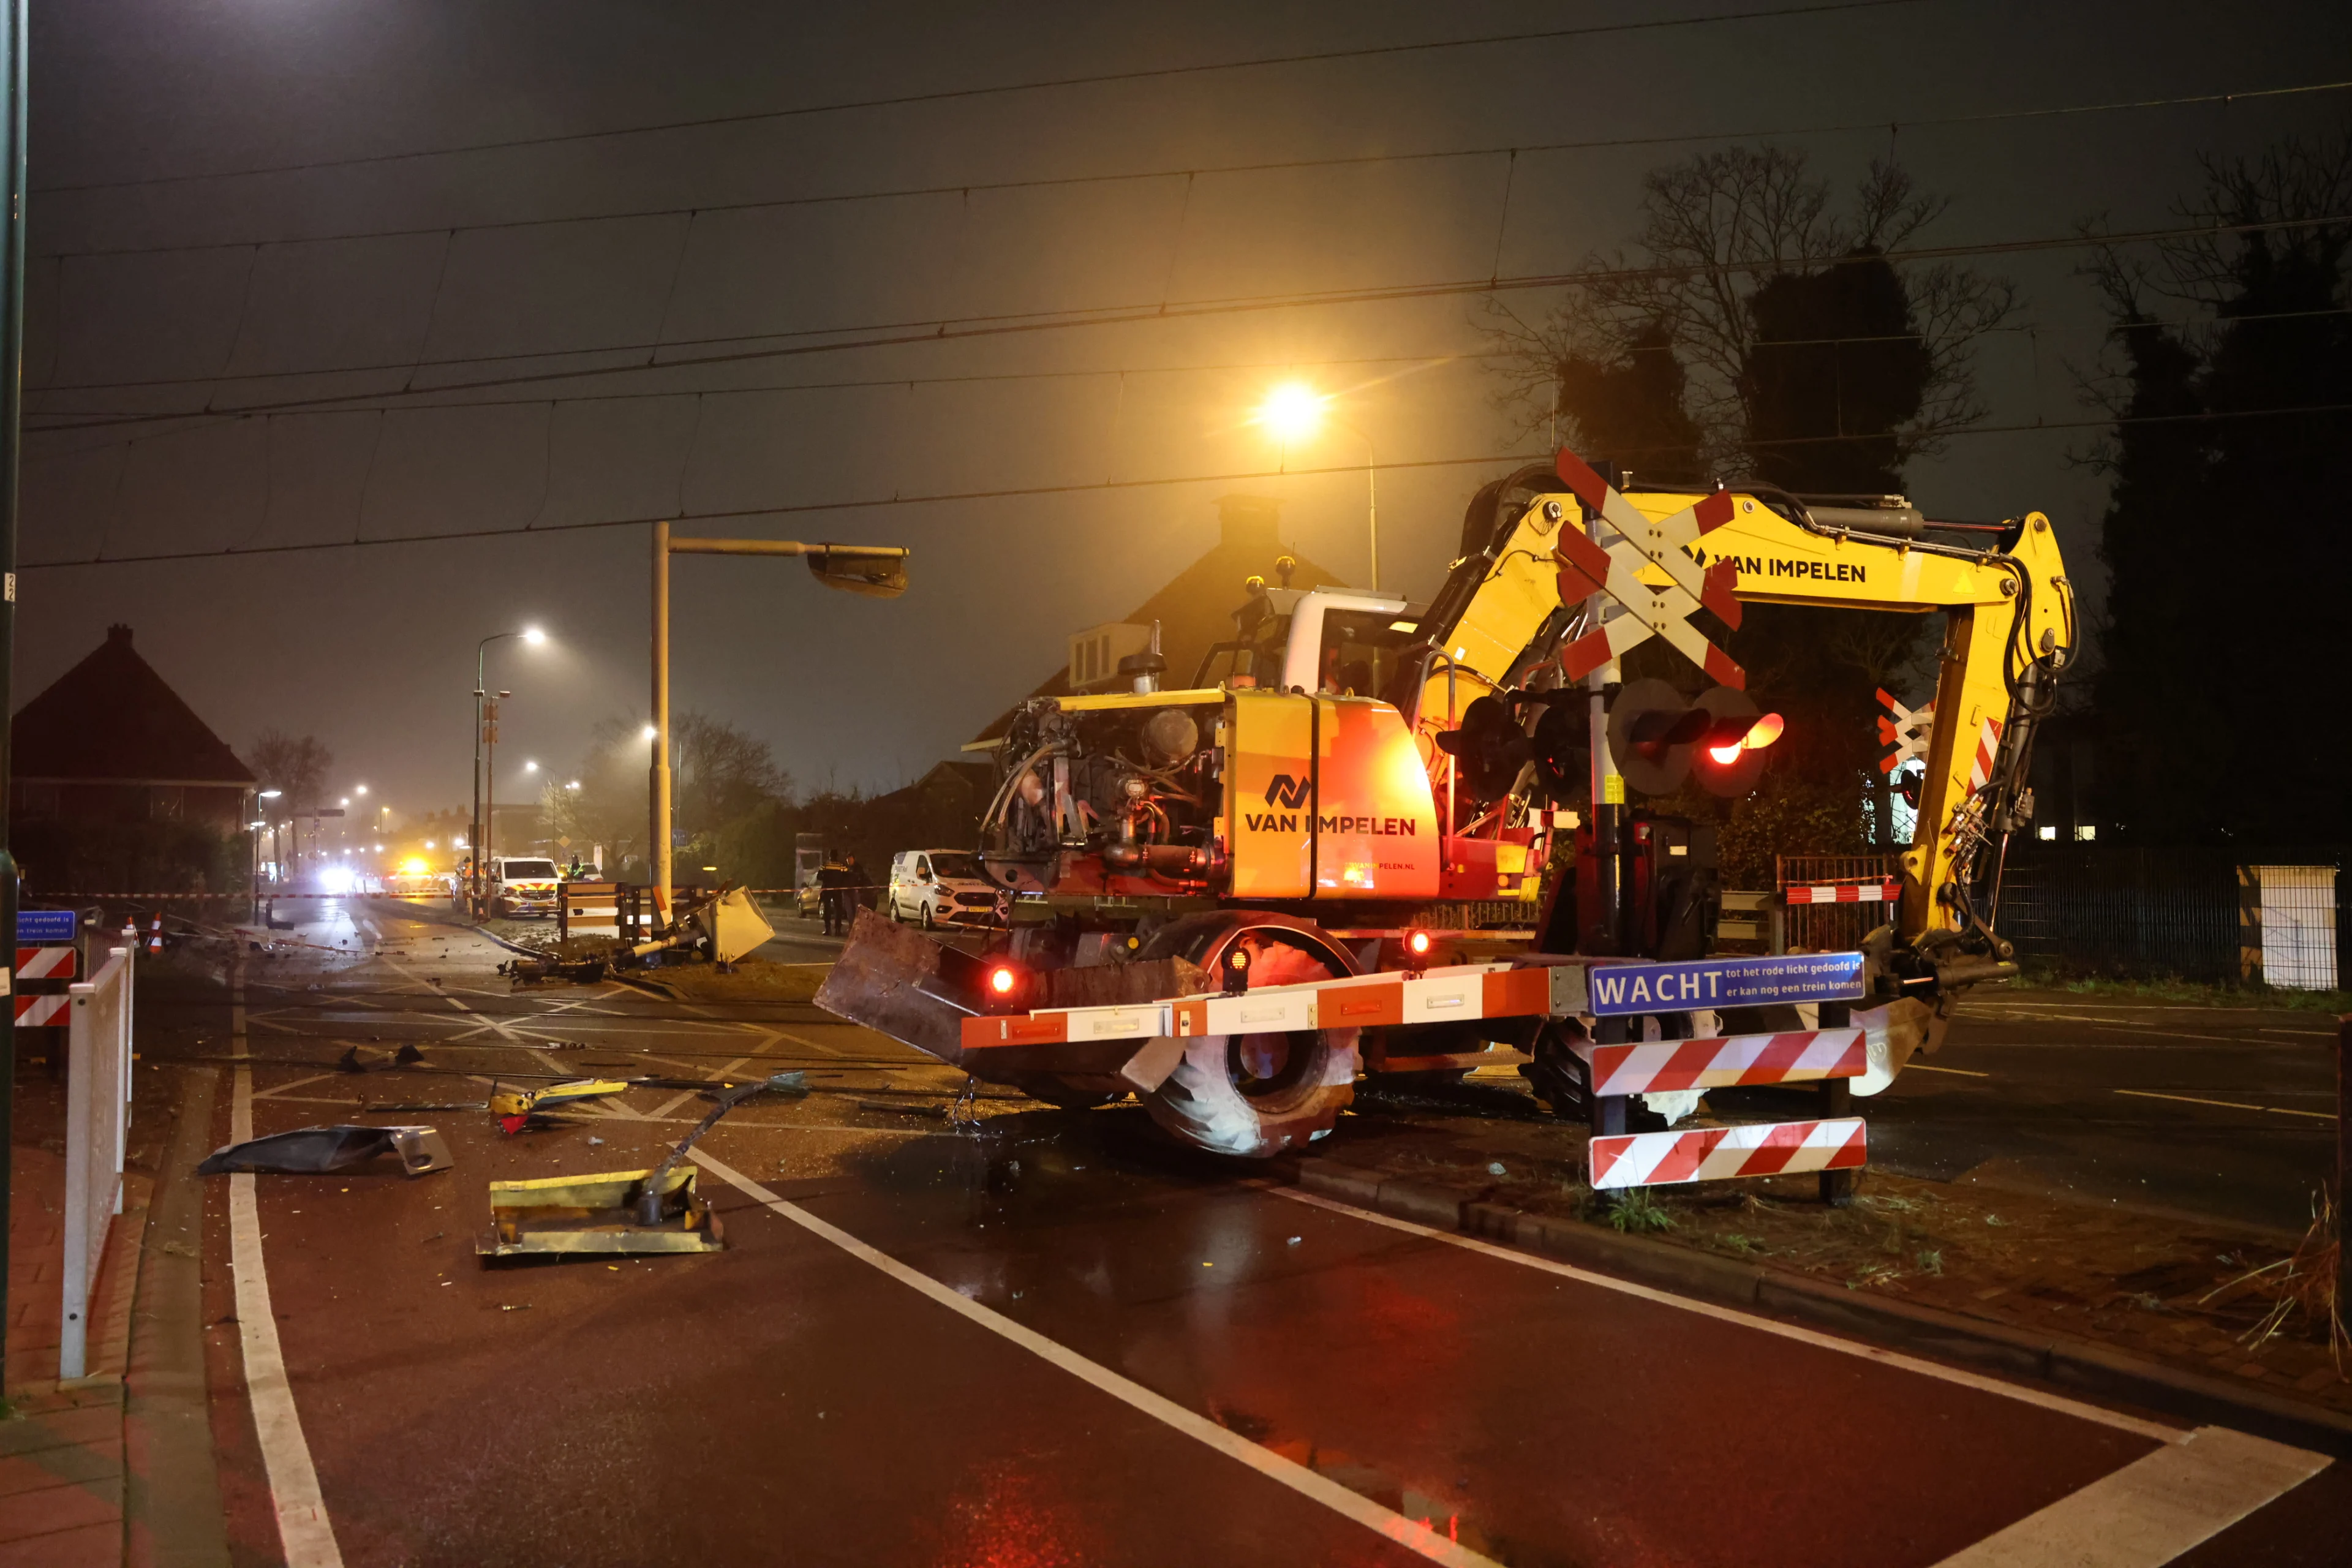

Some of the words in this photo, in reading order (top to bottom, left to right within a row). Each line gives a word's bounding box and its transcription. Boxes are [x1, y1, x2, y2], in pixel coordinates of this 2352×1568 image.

[1769, 558, 1866, 582] IMPELEN
[1245, 813, 1297, 832] VAN
[1305, 815, 1415, 836] IMPELEN
[1726, 968, 1741, 978] tot
[1743, 968, 1759, 977] het
[1762, 966, 1784, 976] rode
[1787, 964, 1808, 974] licht
[1811, 961, 1850, 975] gedoofd
[1852, 961, 1861, 970] is
[1595, 971, 1722, 1005] WACHT
[1727, 988, 1737, 997] er
[1740, 987, 1757, 996] kan
[1760, 986, 1779, 997] nog
[1782, 984, 1800, 993] een
[1803, 981, 1826, 992] trein
[1829, 981, 1862, 990] komen
